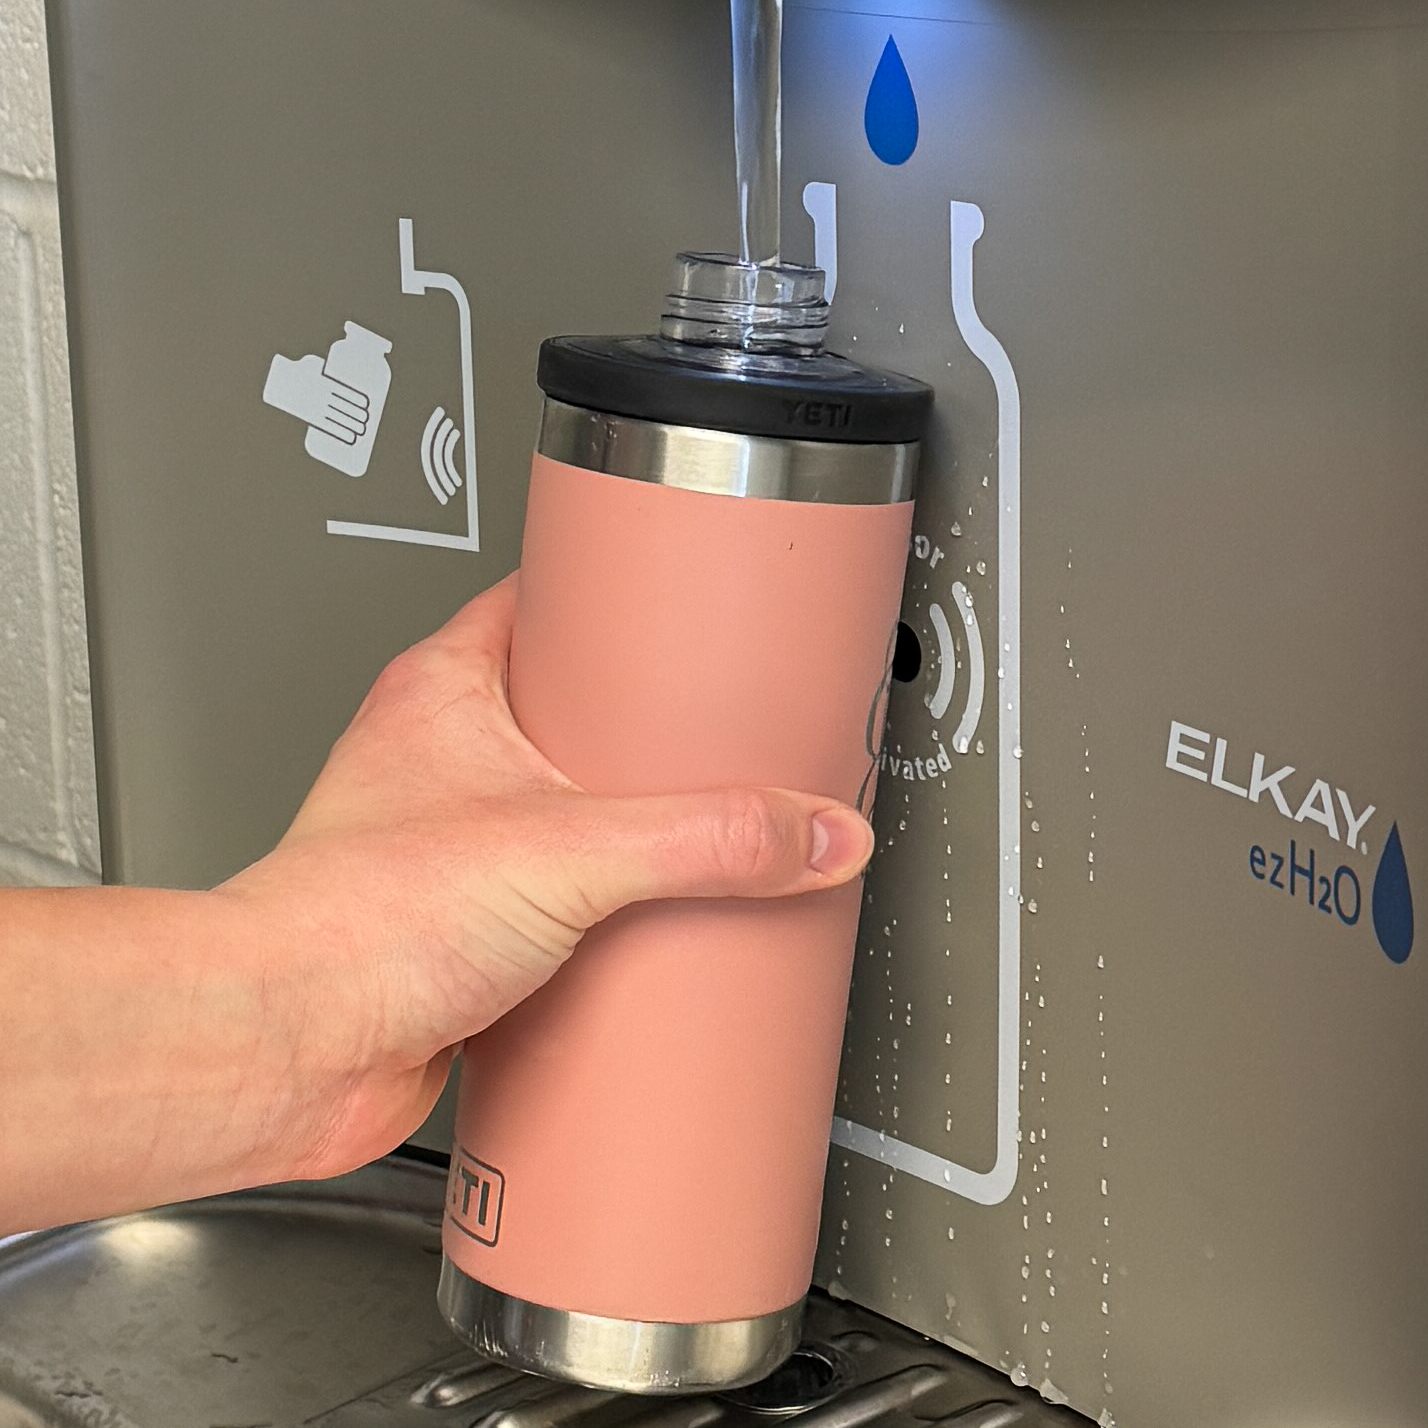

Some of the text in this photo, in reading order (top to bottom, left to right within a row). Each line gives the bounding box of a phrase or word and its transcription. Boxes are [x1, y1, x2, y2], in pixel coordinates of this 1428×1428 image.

[783, 397, 851, 428] YETI
[881, 743, 952, 781] ivated
[1165, 720, 1376, 850] ELKAY
[454, 1164, 491, 1227] TI
